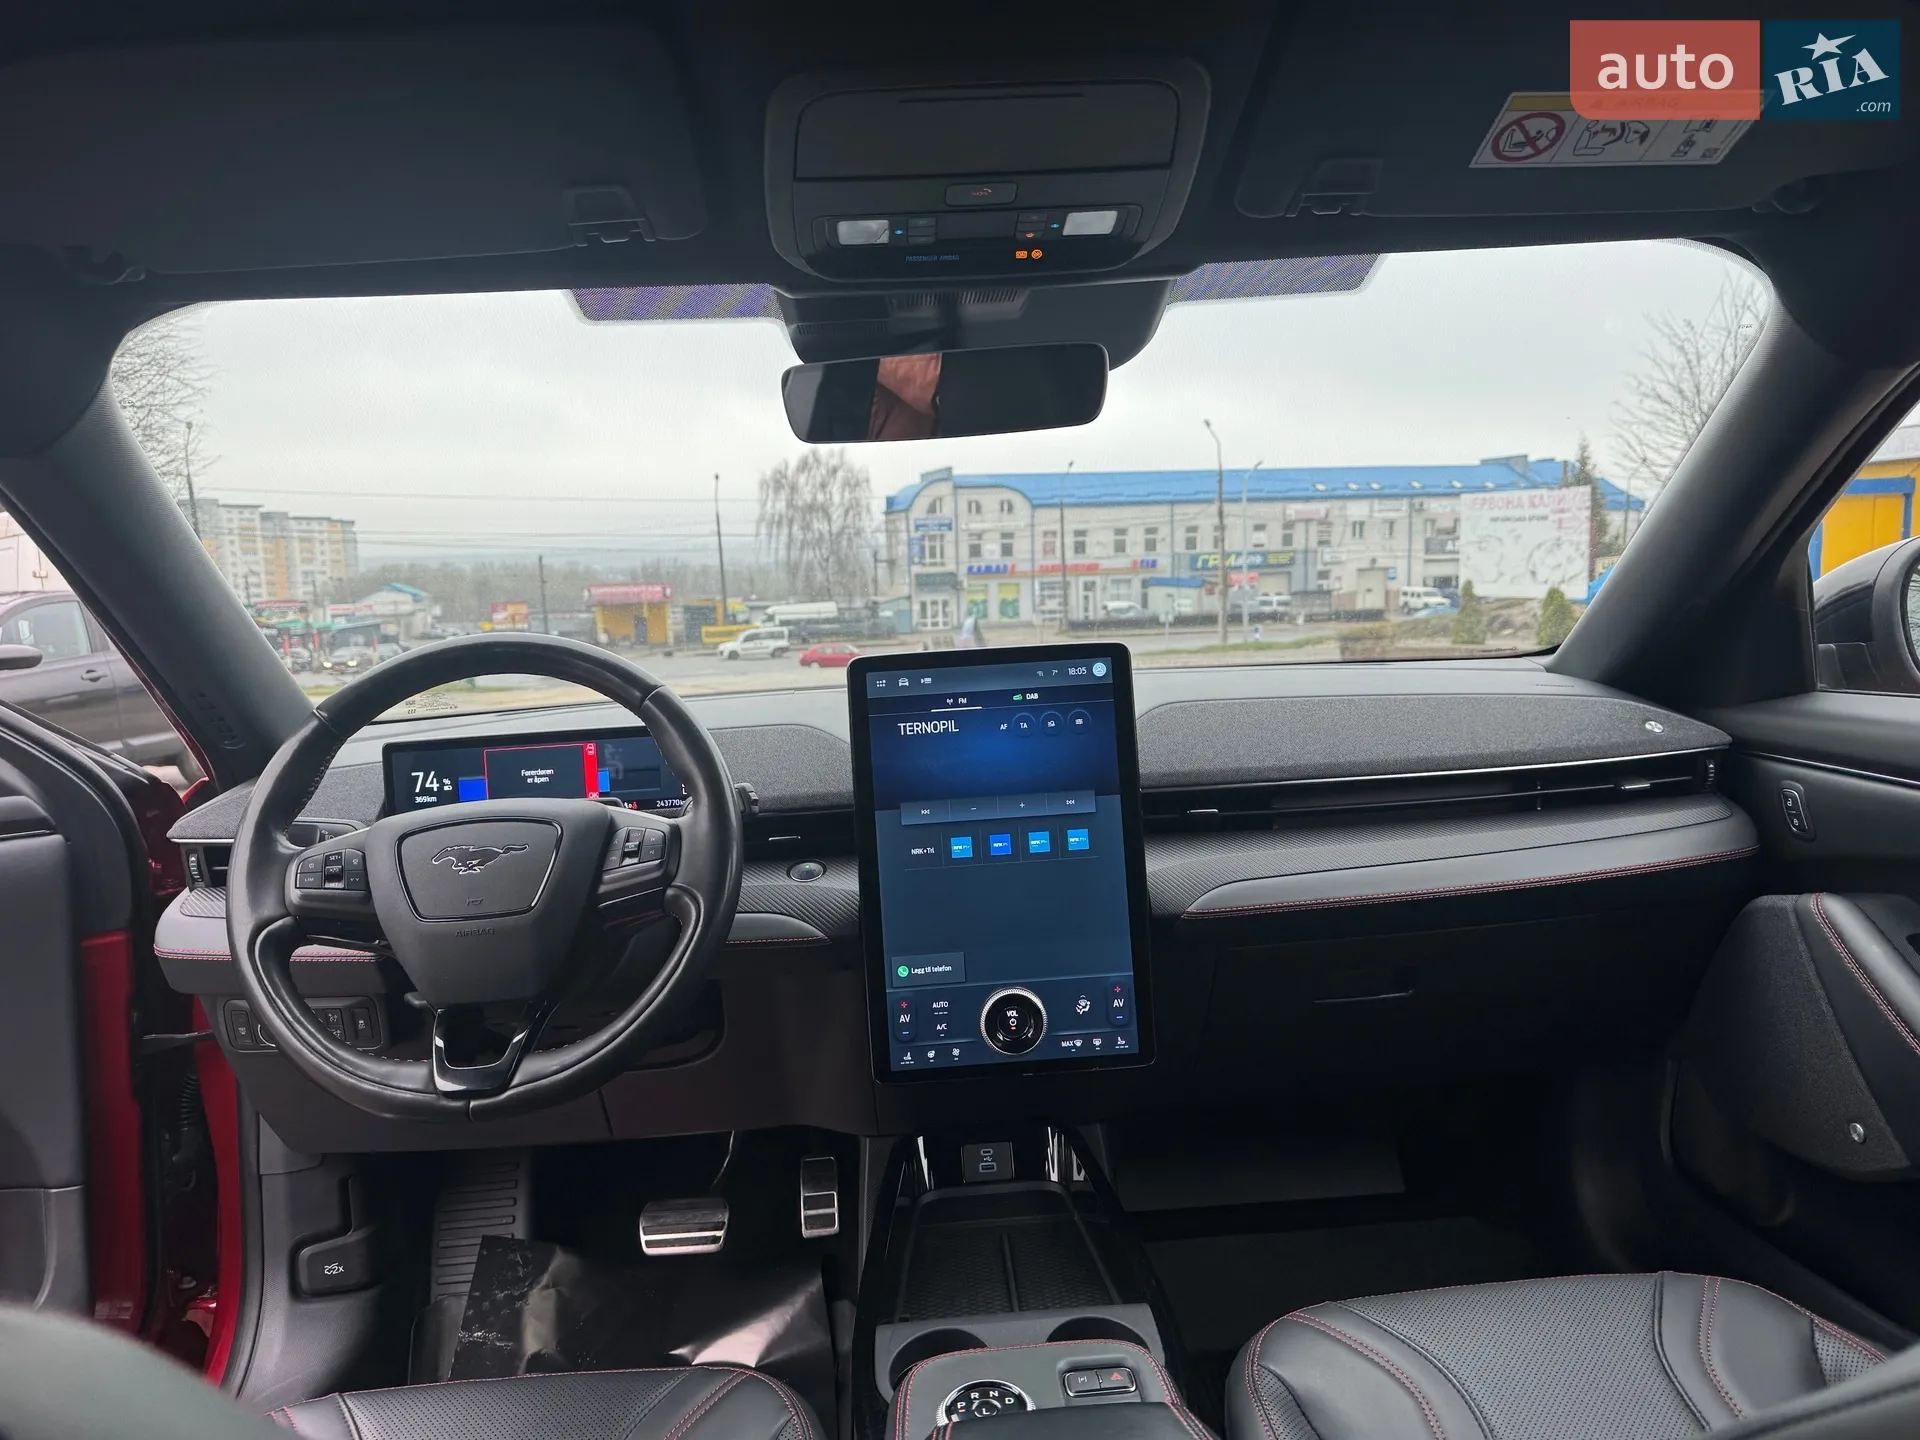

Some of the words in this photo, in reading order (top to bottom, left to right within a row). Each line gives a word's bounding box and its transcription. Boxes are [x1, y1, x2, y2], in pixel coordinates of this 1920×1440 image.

[939, 254, 960, 262] AIRBAG
[1068, 666, 1087, 676] 18:05
[897, 719, 960, 736] TERNOPIL
[1000, 723, 1008, 731] AF
[411, 770, 440, 793] 74
[455, 927, 495, 937] AIRBAG
[932, 964, 952, 973] telefon
[1113, 998, 1124, 1008] AV
[899, 1014, 910, 1023] AV
[957, 1401, 966, 1409] P
[989, 1390, 999, 1398] N
[982, 1407, 991, 1415] L
